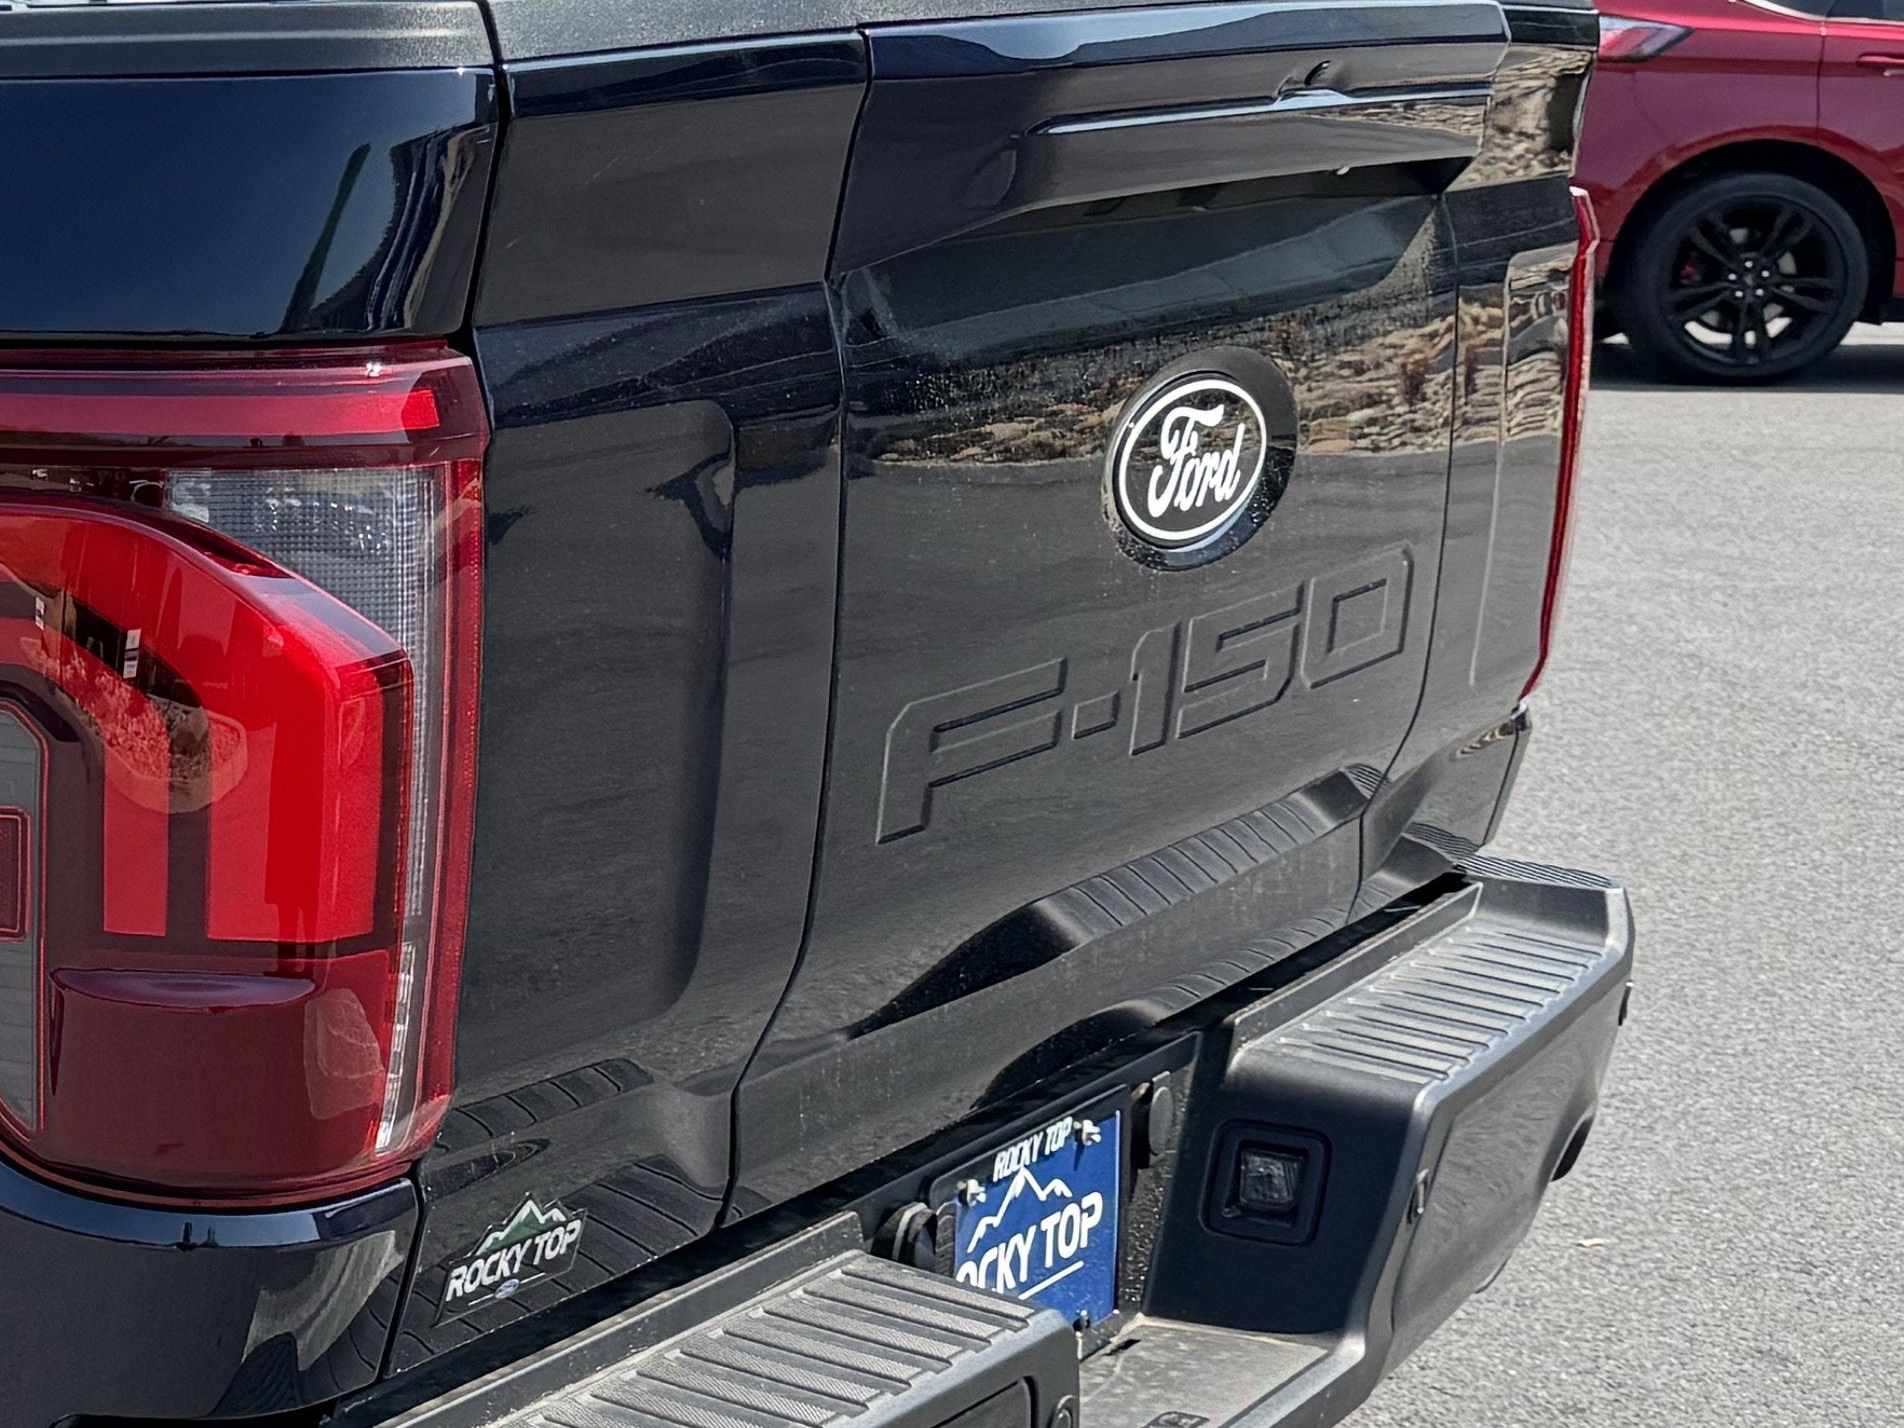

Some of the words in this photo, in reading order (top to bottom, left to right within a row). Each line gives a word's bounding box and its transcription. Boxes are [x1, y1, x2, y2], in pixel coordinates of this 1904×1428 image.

[1146, 402, 1246, 519] Ford
[875, 544, 1416, 846] F-150
[993, 1132, 1045, 1183] ROCKY
[1045, 1115, 1073, 1155] TOP
[444, 1237, 534, 1302] ROCKY
[532, 1219, 583, 1266] TOP
[1040, 1191, 1104, 1269] TOP
